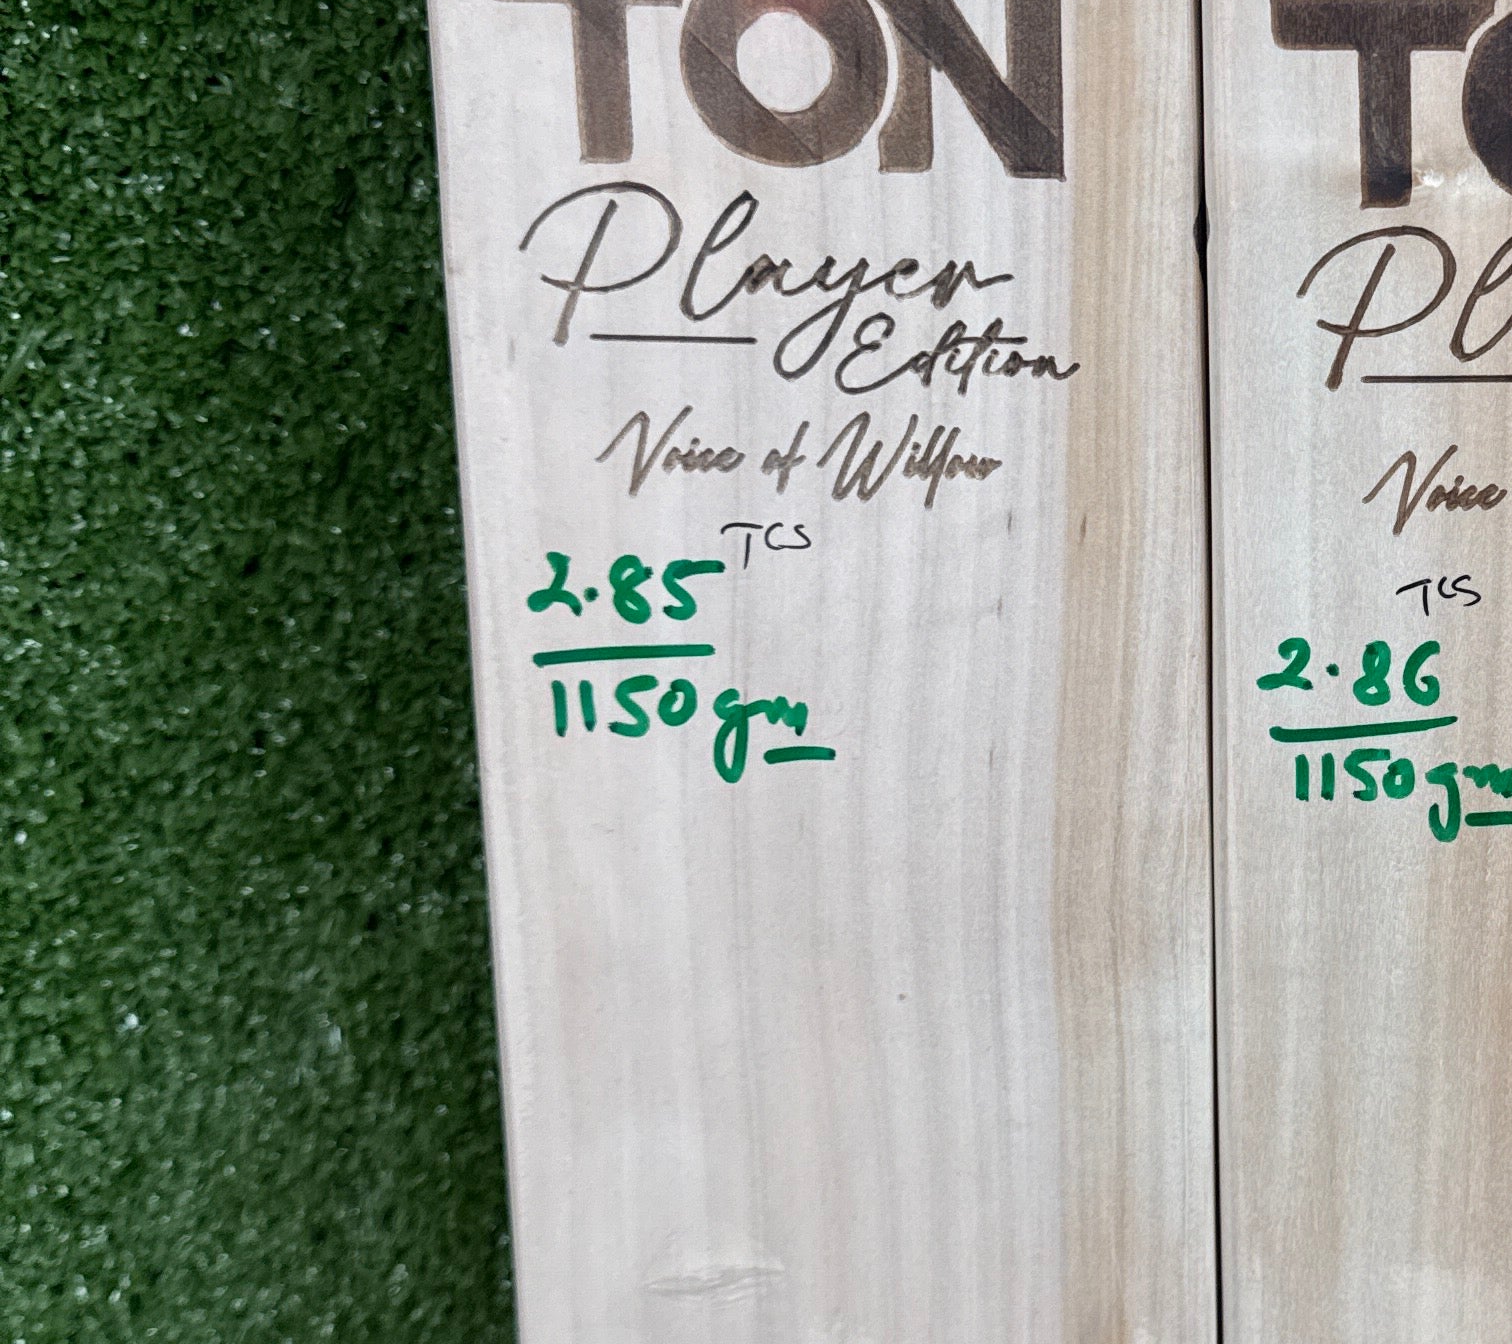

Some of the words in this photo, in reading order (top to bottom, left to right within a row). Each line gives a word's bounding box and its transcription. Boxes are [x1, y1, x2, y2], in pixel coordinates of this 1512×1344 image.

[519, 181, 1014, 380] Player
[835, 312, 1080, 395] Edition
[596, 405, 745, 499] Voice
[761, 421, 809, 494] of
[817, 412, 1003, 509] Willow
[1362, 444, 1508, 537] Voice
[720, 522, 812, 570] TCS
[527, 551, 725, 624] 2.85
[1395, 575, 1481, 616] TCS
[1256, 637, 1441, 707] 2.86
